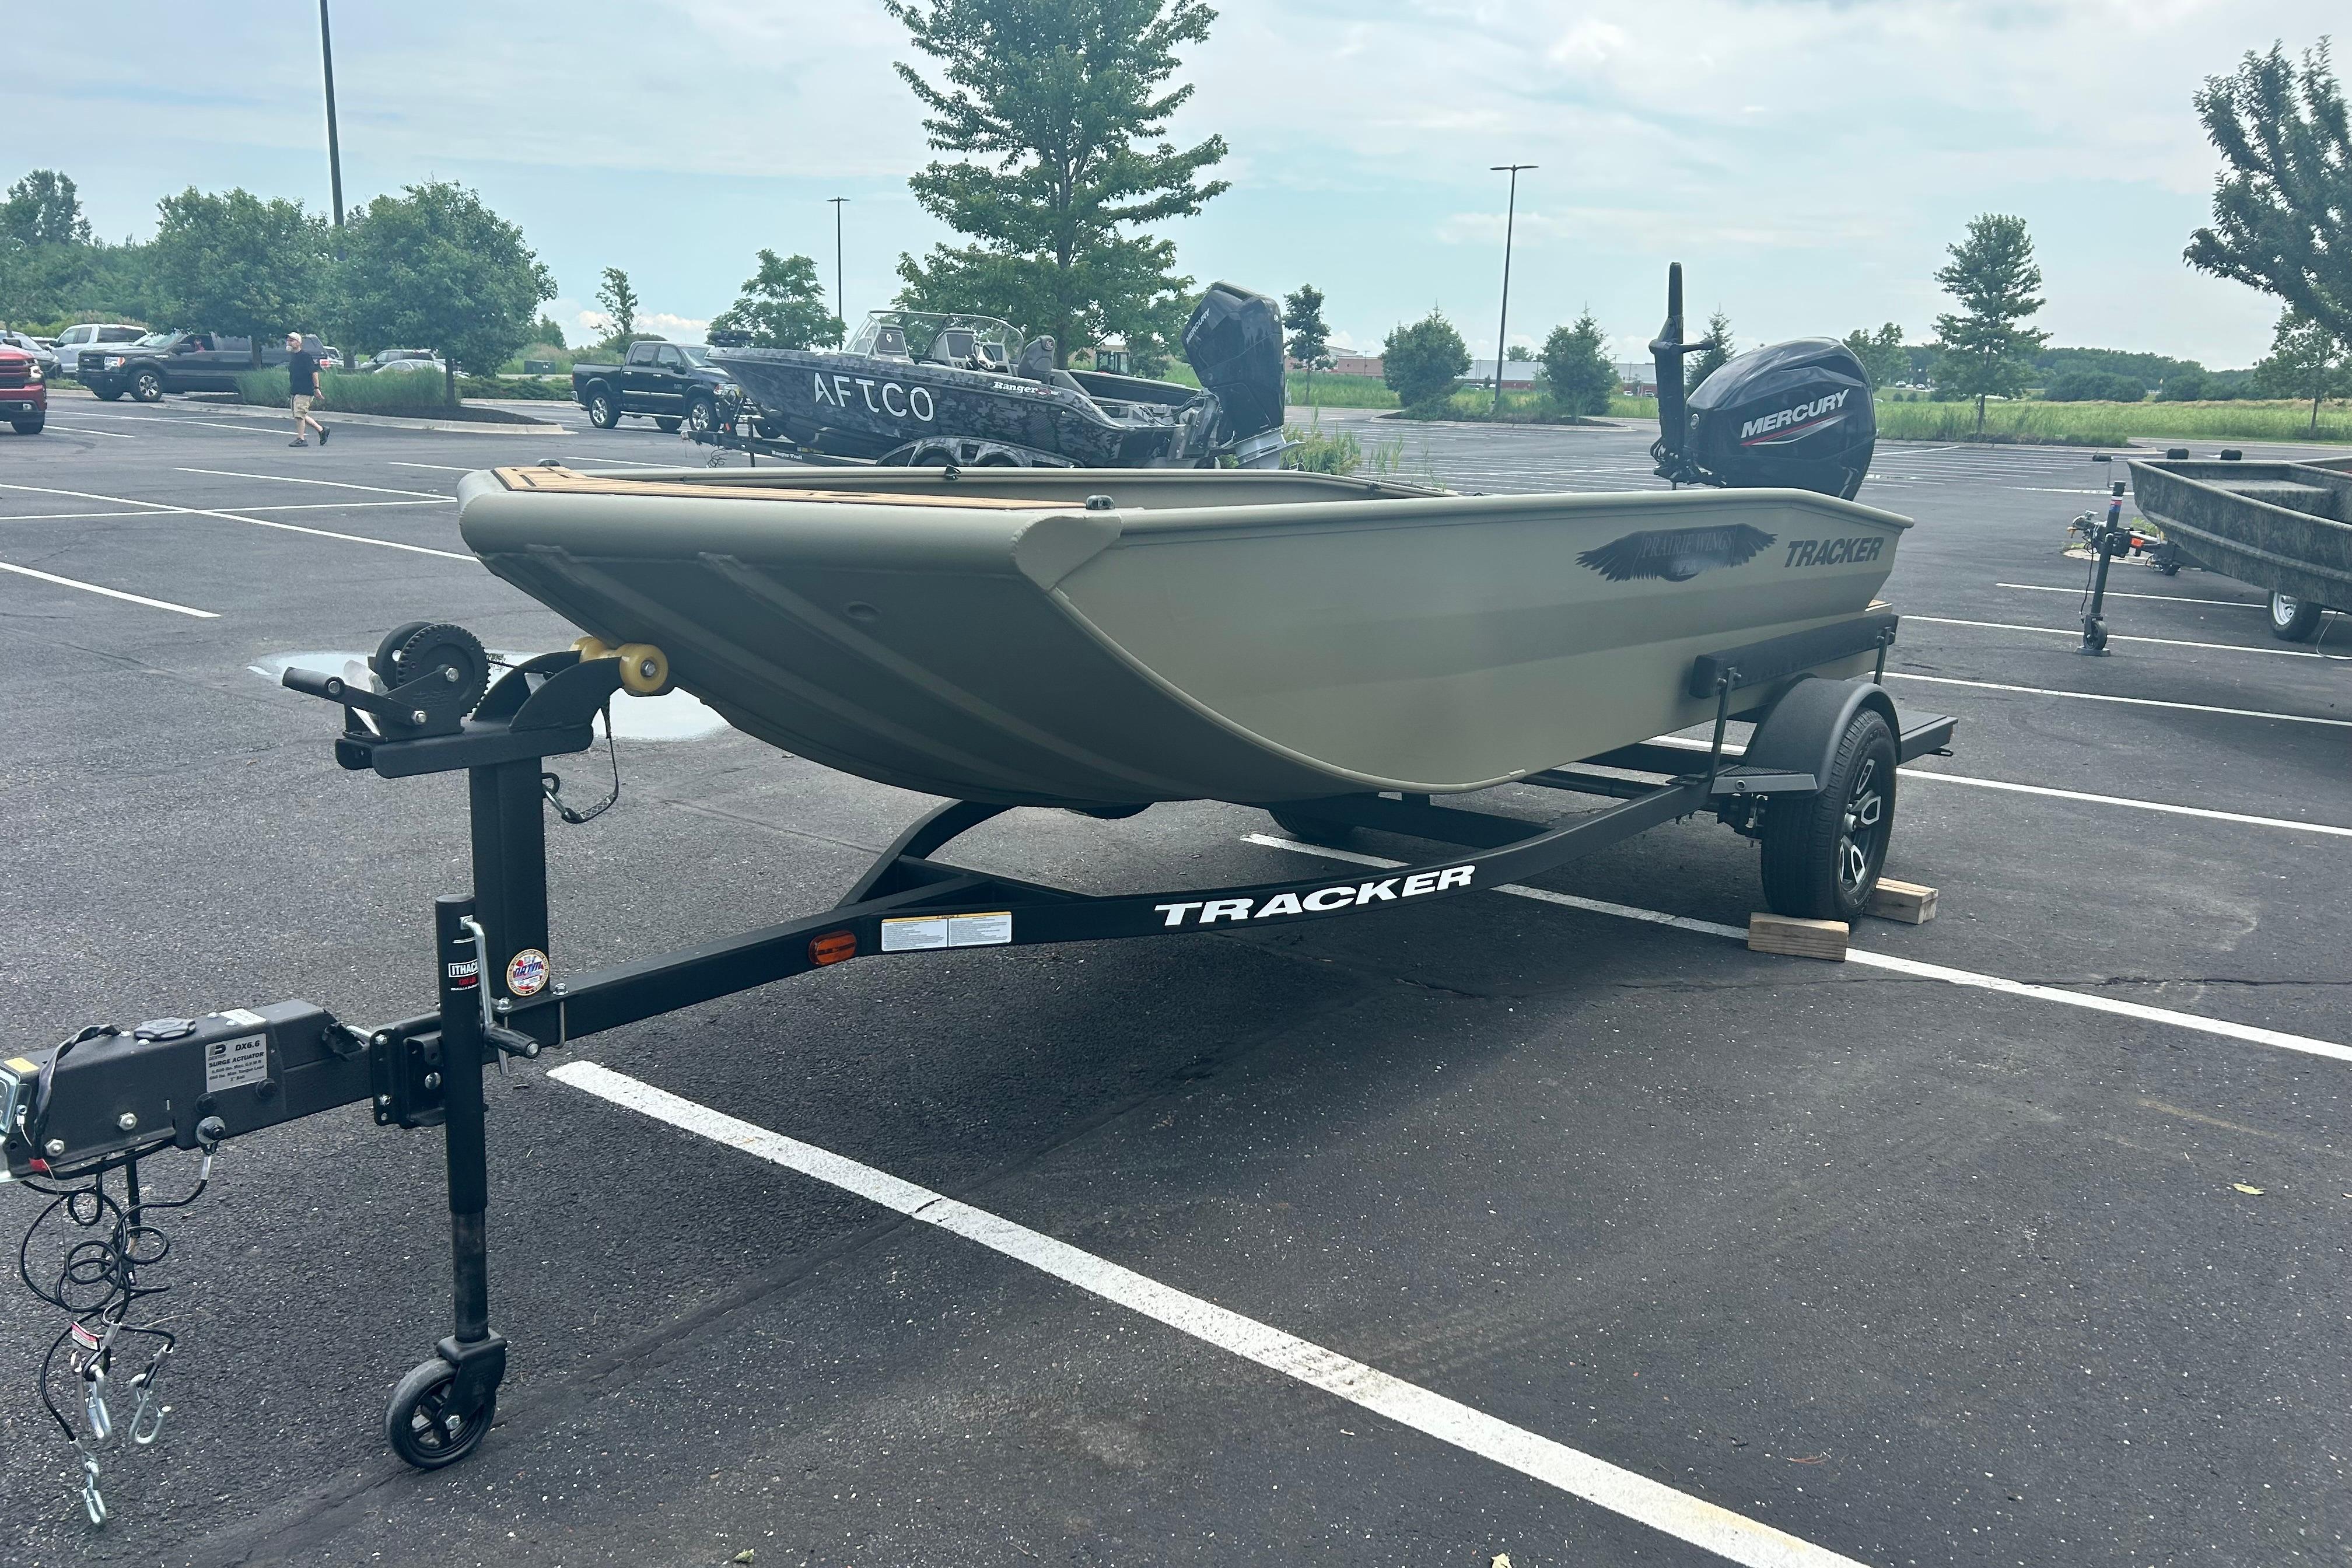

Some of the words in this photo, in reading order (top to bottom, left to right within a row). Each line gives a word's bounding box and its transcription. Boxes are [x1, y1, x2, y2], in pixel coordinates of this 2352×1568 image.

[1186, 307, 1209, 344] MERCURY
[814, 372, 934, 422] AFTCO
[993, 381, 1038, 394] Ranger
[1741, 388, 1849, 439] MERCURY
[1642, 534, 1695, 558] PRAIRIE
[1695, 530, 1734, 552] WINGS
[1784, 537, 1885, 568] TRACKER
[1154, 865, 1476, 926] TRACKER
[209, 1058, 232, 1068] SURGE
[232, 1052, 264, 1062] ACTUATOR
[235, 1040, 260, 1051] DX6.6
